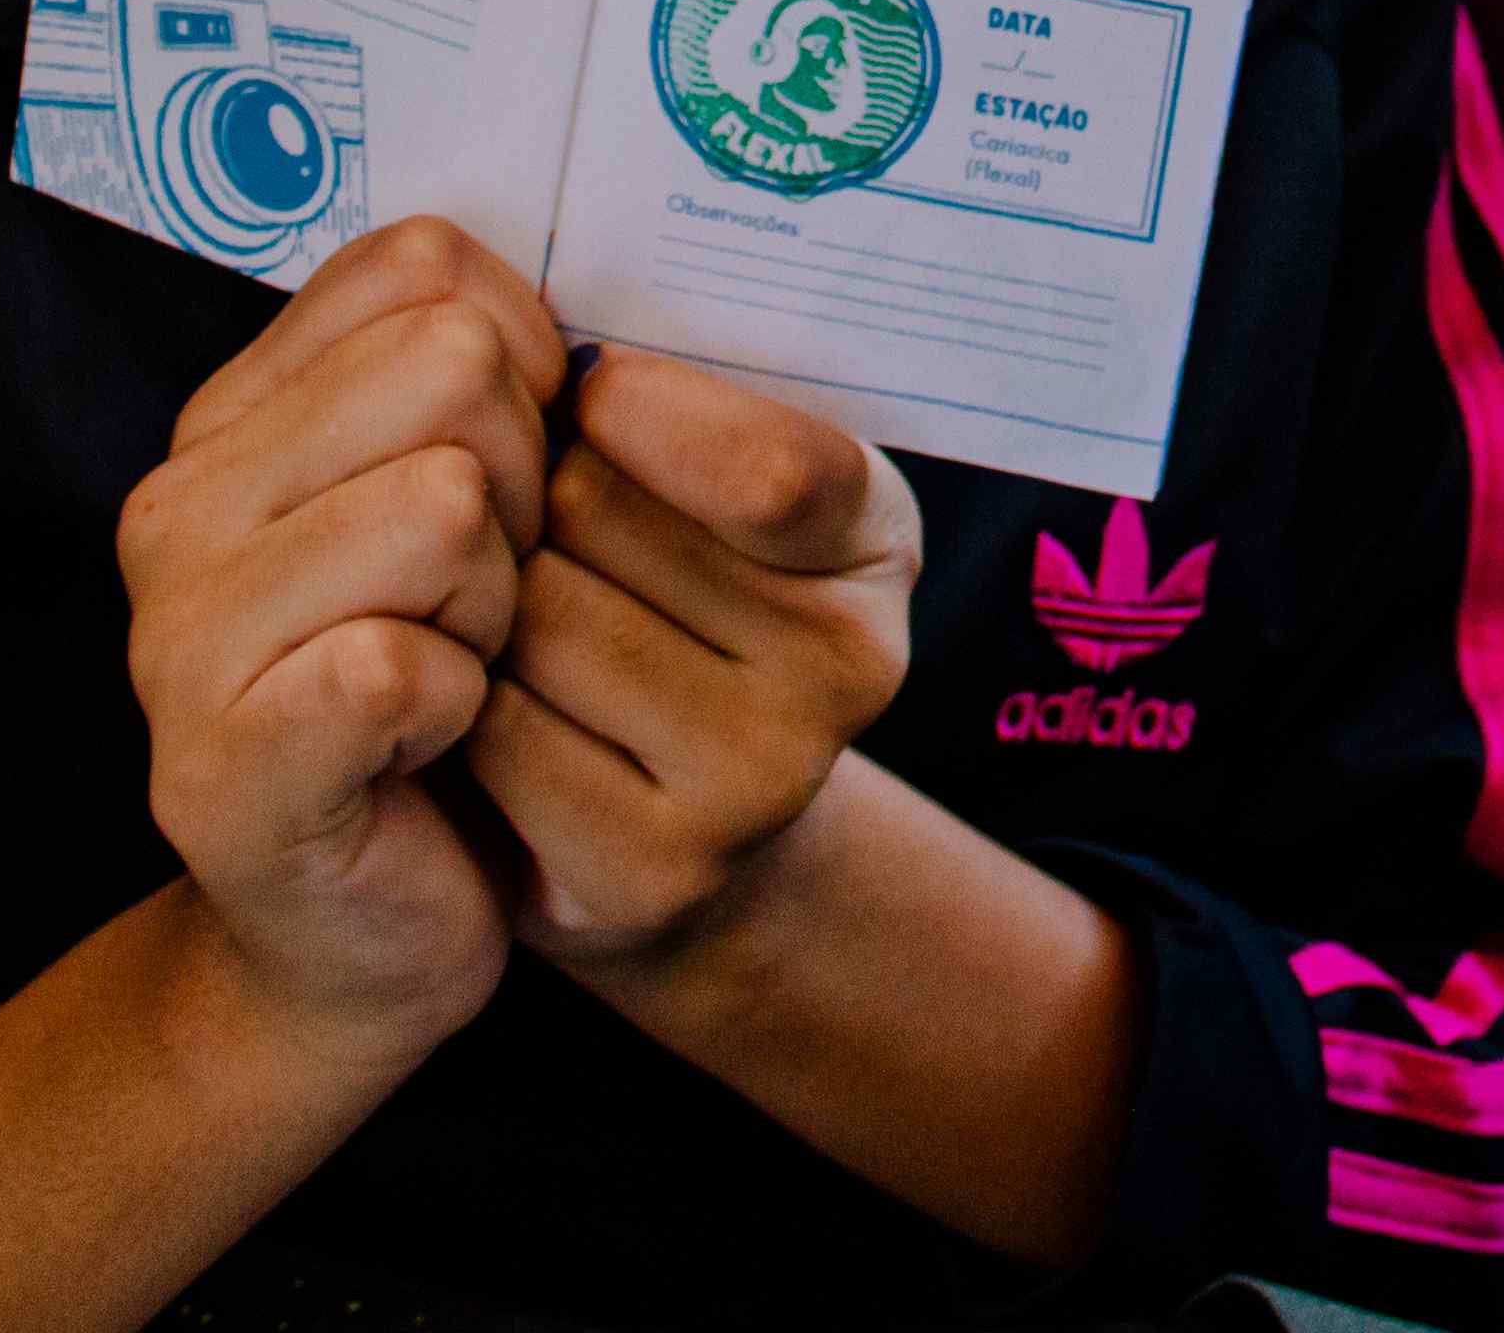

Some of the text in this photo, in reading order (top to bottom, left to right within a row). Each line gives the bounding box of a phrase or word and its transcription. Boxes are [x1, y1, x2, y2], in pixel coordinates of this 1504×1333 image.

[987, 6, 1052, 40] DATA
[974, 91, 1089, 132] ESTAÇÃO
[710, 109, 836, 176] FLEXAL
[969, 129, 1071, 166] Cariacica
[964, 157, 1042, 193] (Flexal)
[995, 685, 1196, 752] adidas
